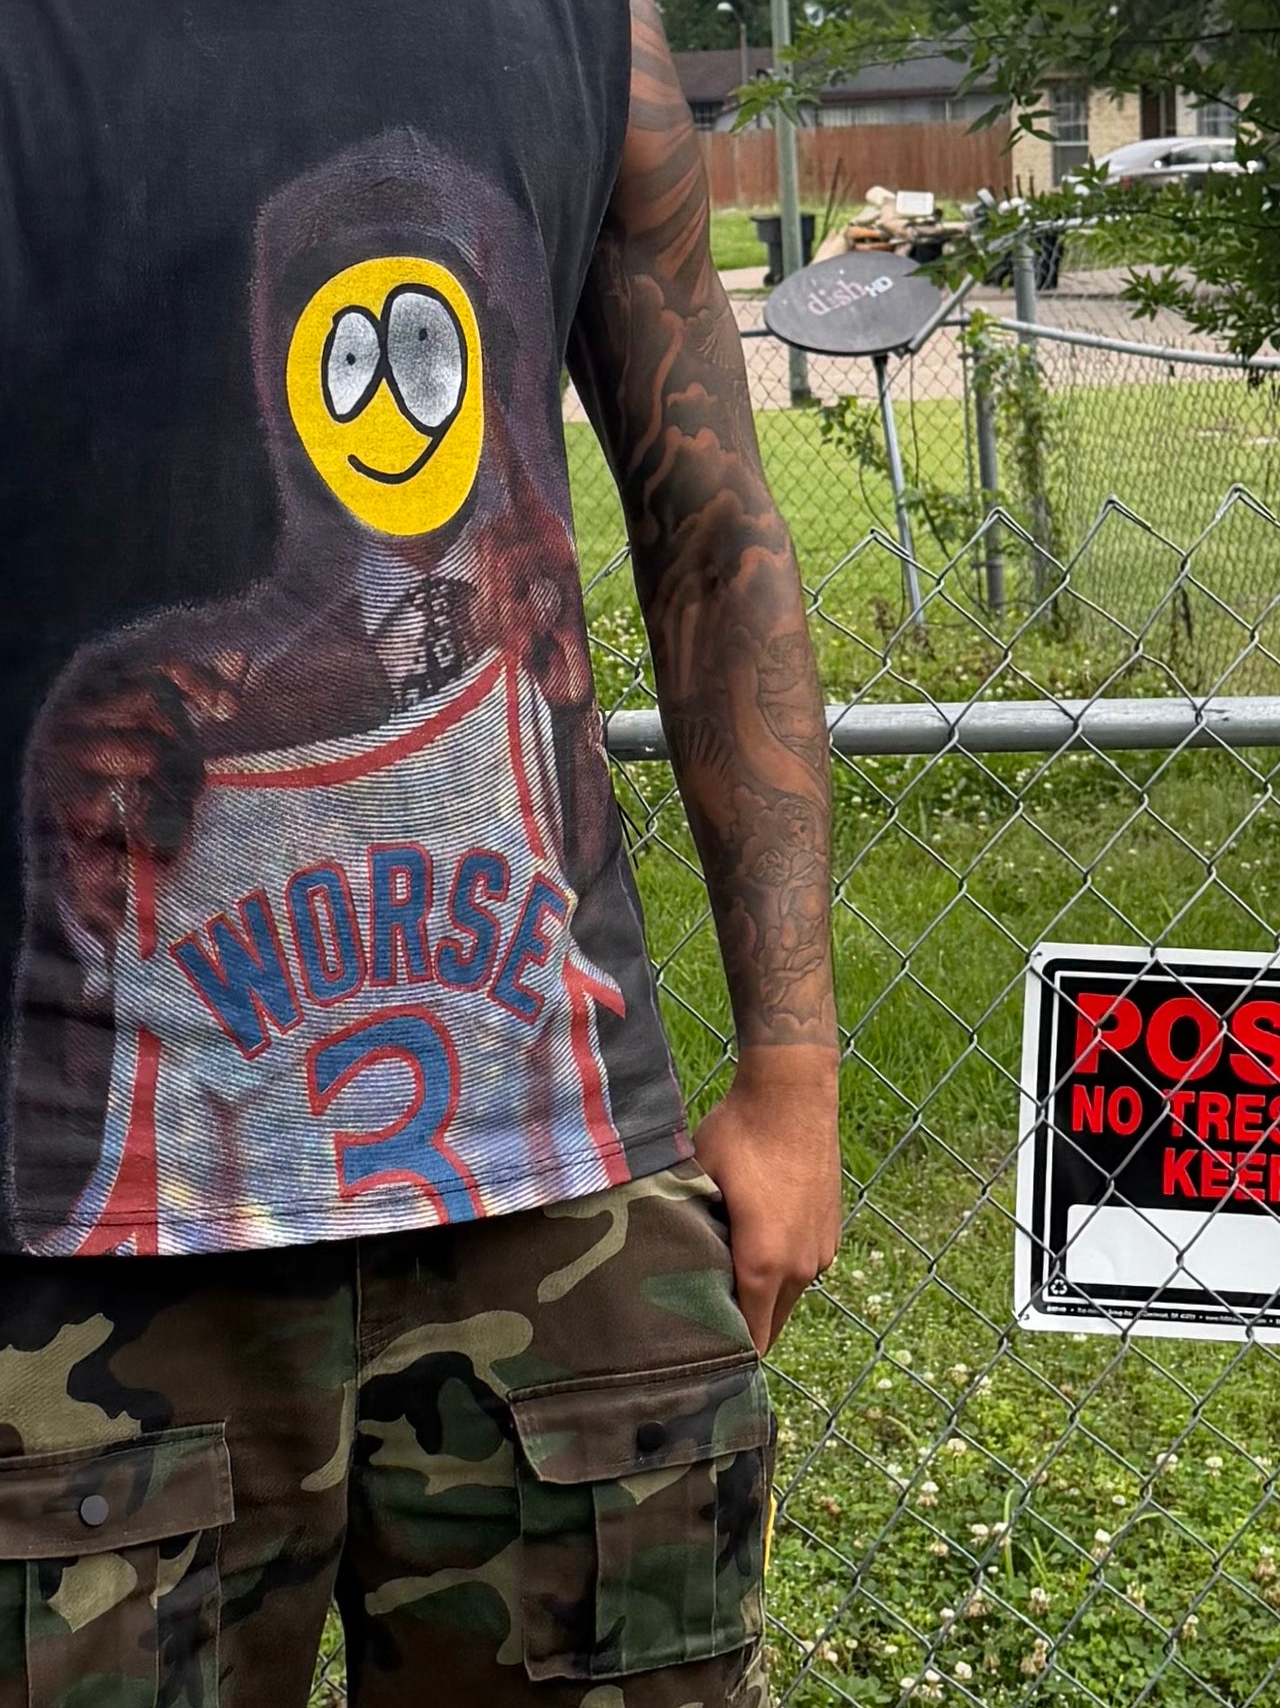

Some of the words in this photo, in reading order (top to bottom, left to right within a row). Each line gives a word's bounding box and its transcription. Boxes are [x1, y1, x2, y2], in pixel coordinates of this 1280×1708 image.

[169, 843, 577, 1060] WORSE
[307, 1003, 484, 1225] 3
[1072, 1084, 1143, 1135] NO
